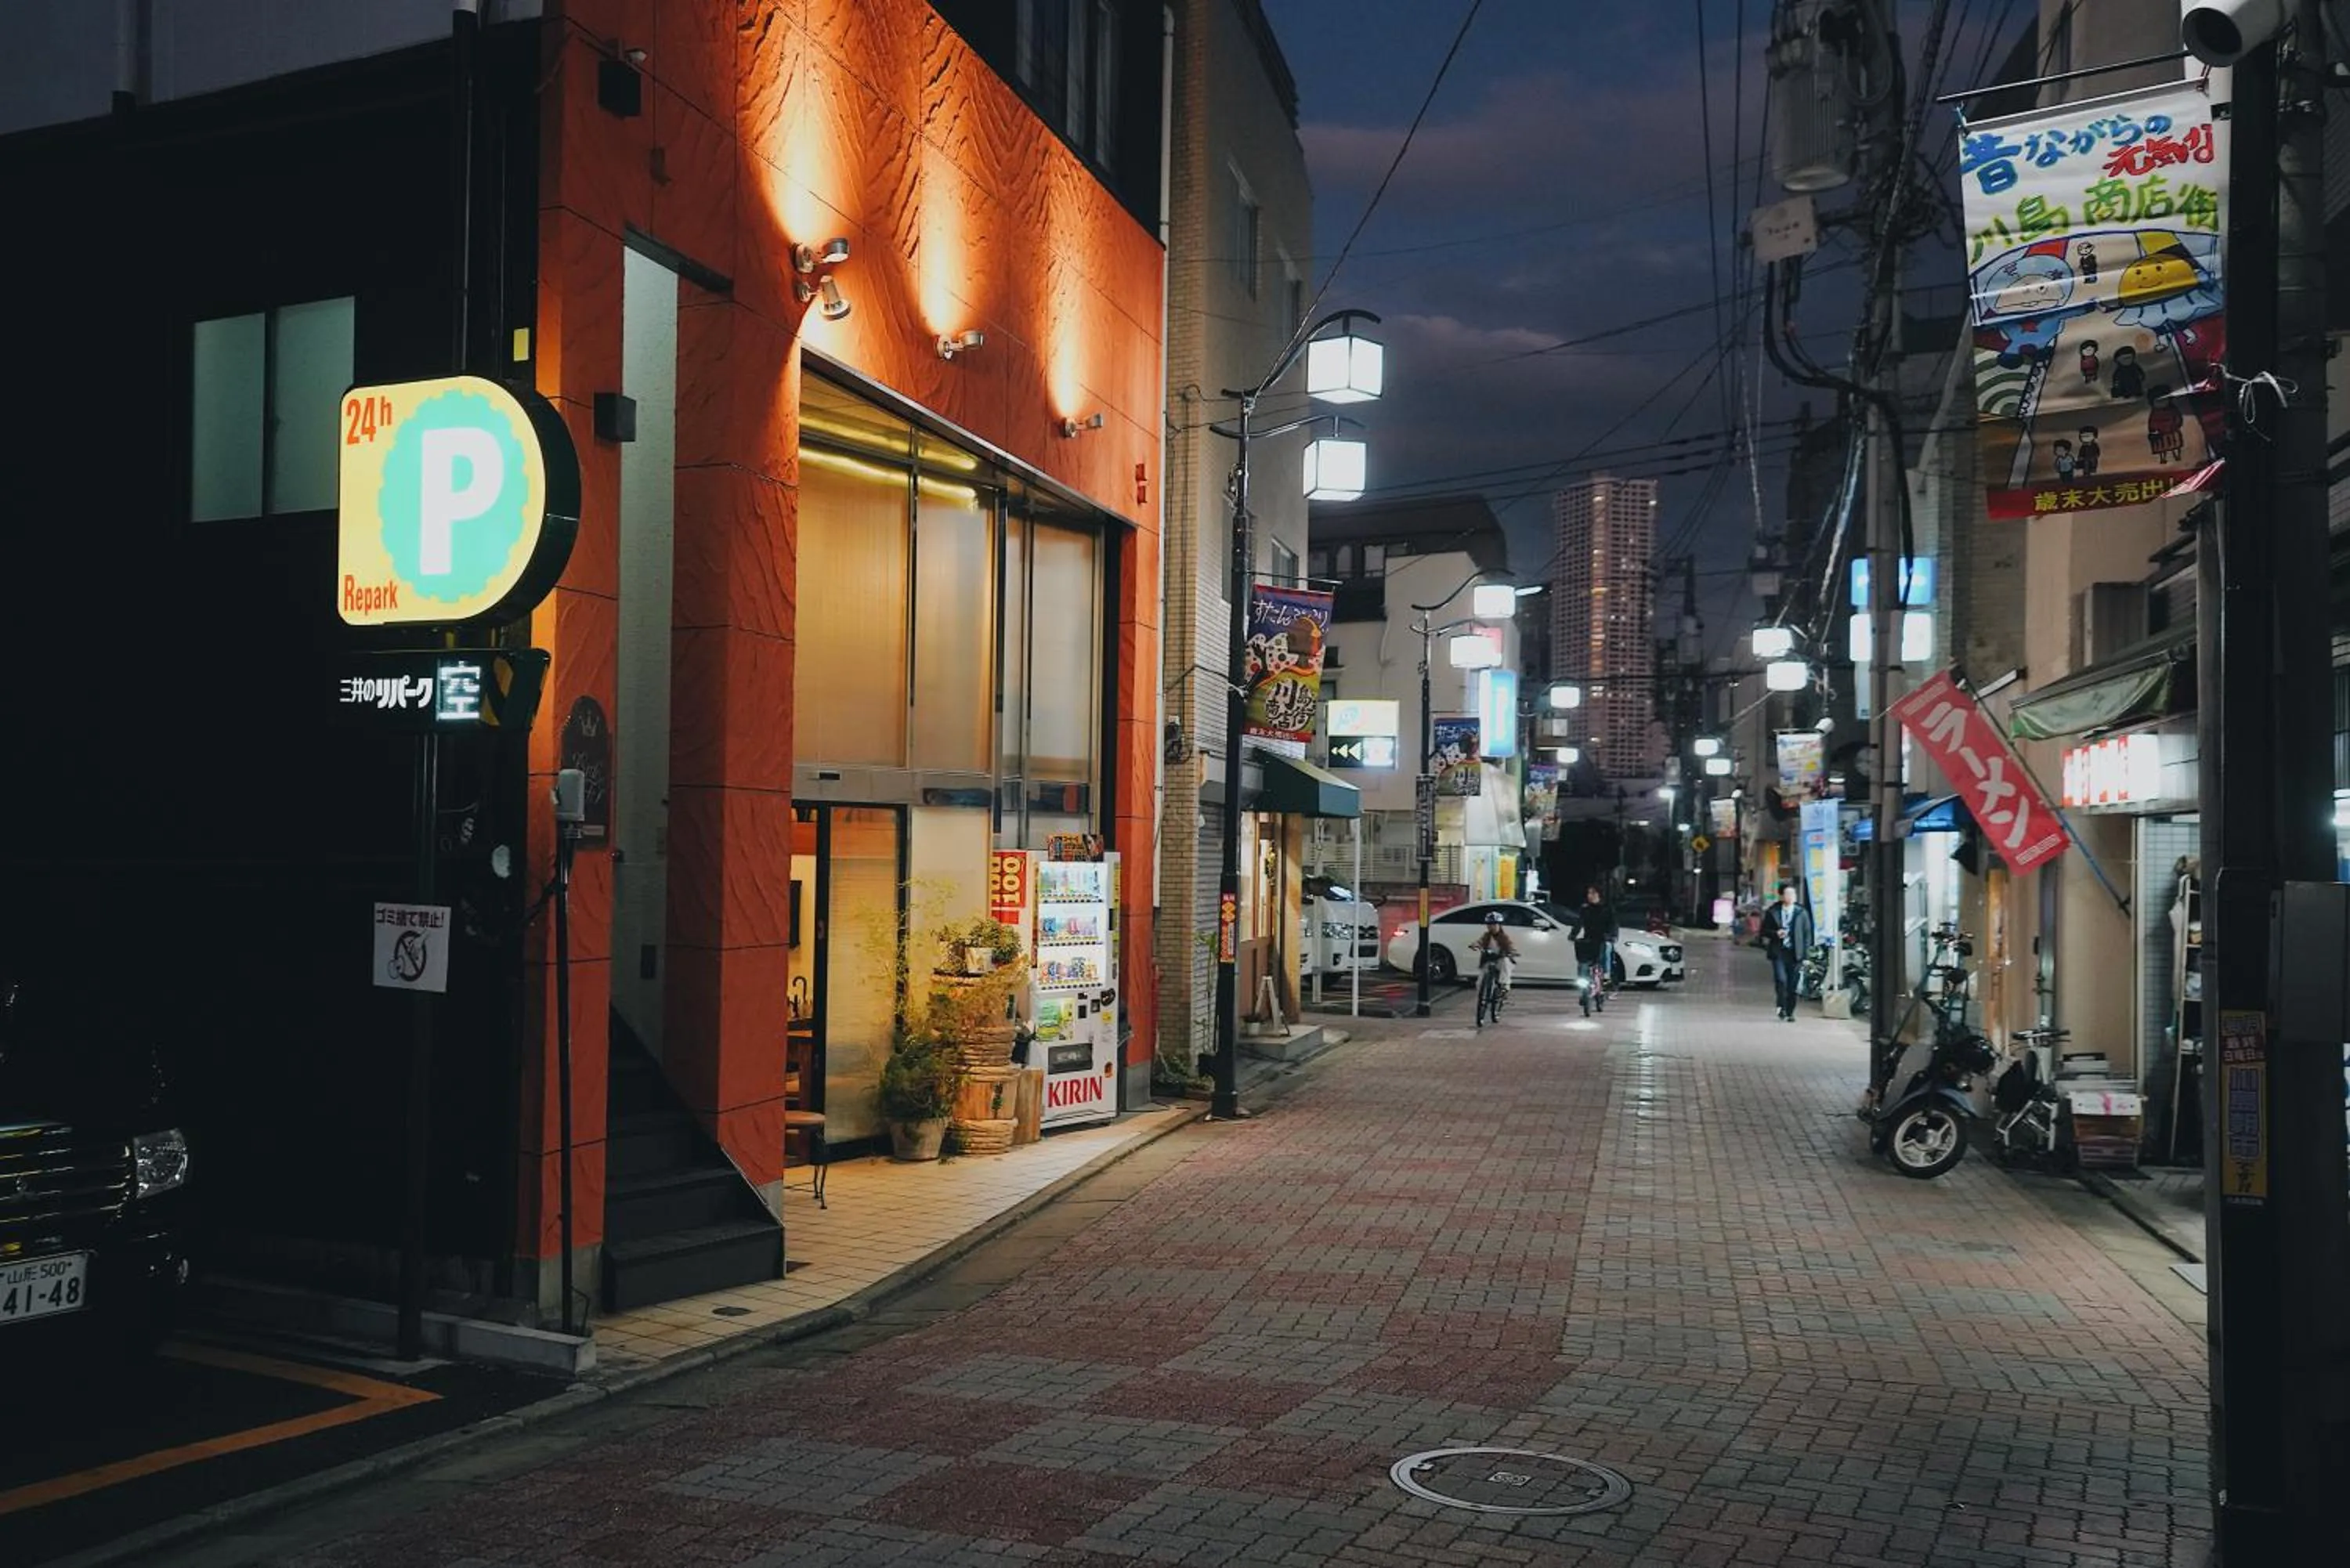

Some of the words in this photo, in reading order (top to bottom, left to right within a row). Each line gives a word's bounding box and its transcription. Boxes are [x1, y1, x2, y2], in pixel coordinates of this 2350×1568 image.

[1960, 114, 2173, 195] 昔ながらの
[346, 396, 392, 445] 24h
[419, 427, 504, 575] P
[344, 574, 398, 616] Repark
[339, 674, 433, 709] 三井のリパーク
[439, 660, 481, 720] 空
[1920, 701, 2030, 848] ラーメン
[1047, 1075, 1104, 1109] KIRIN
[39, 1261, 67, 1279] 500
[3, 1277, 80, 1315] 41-48
